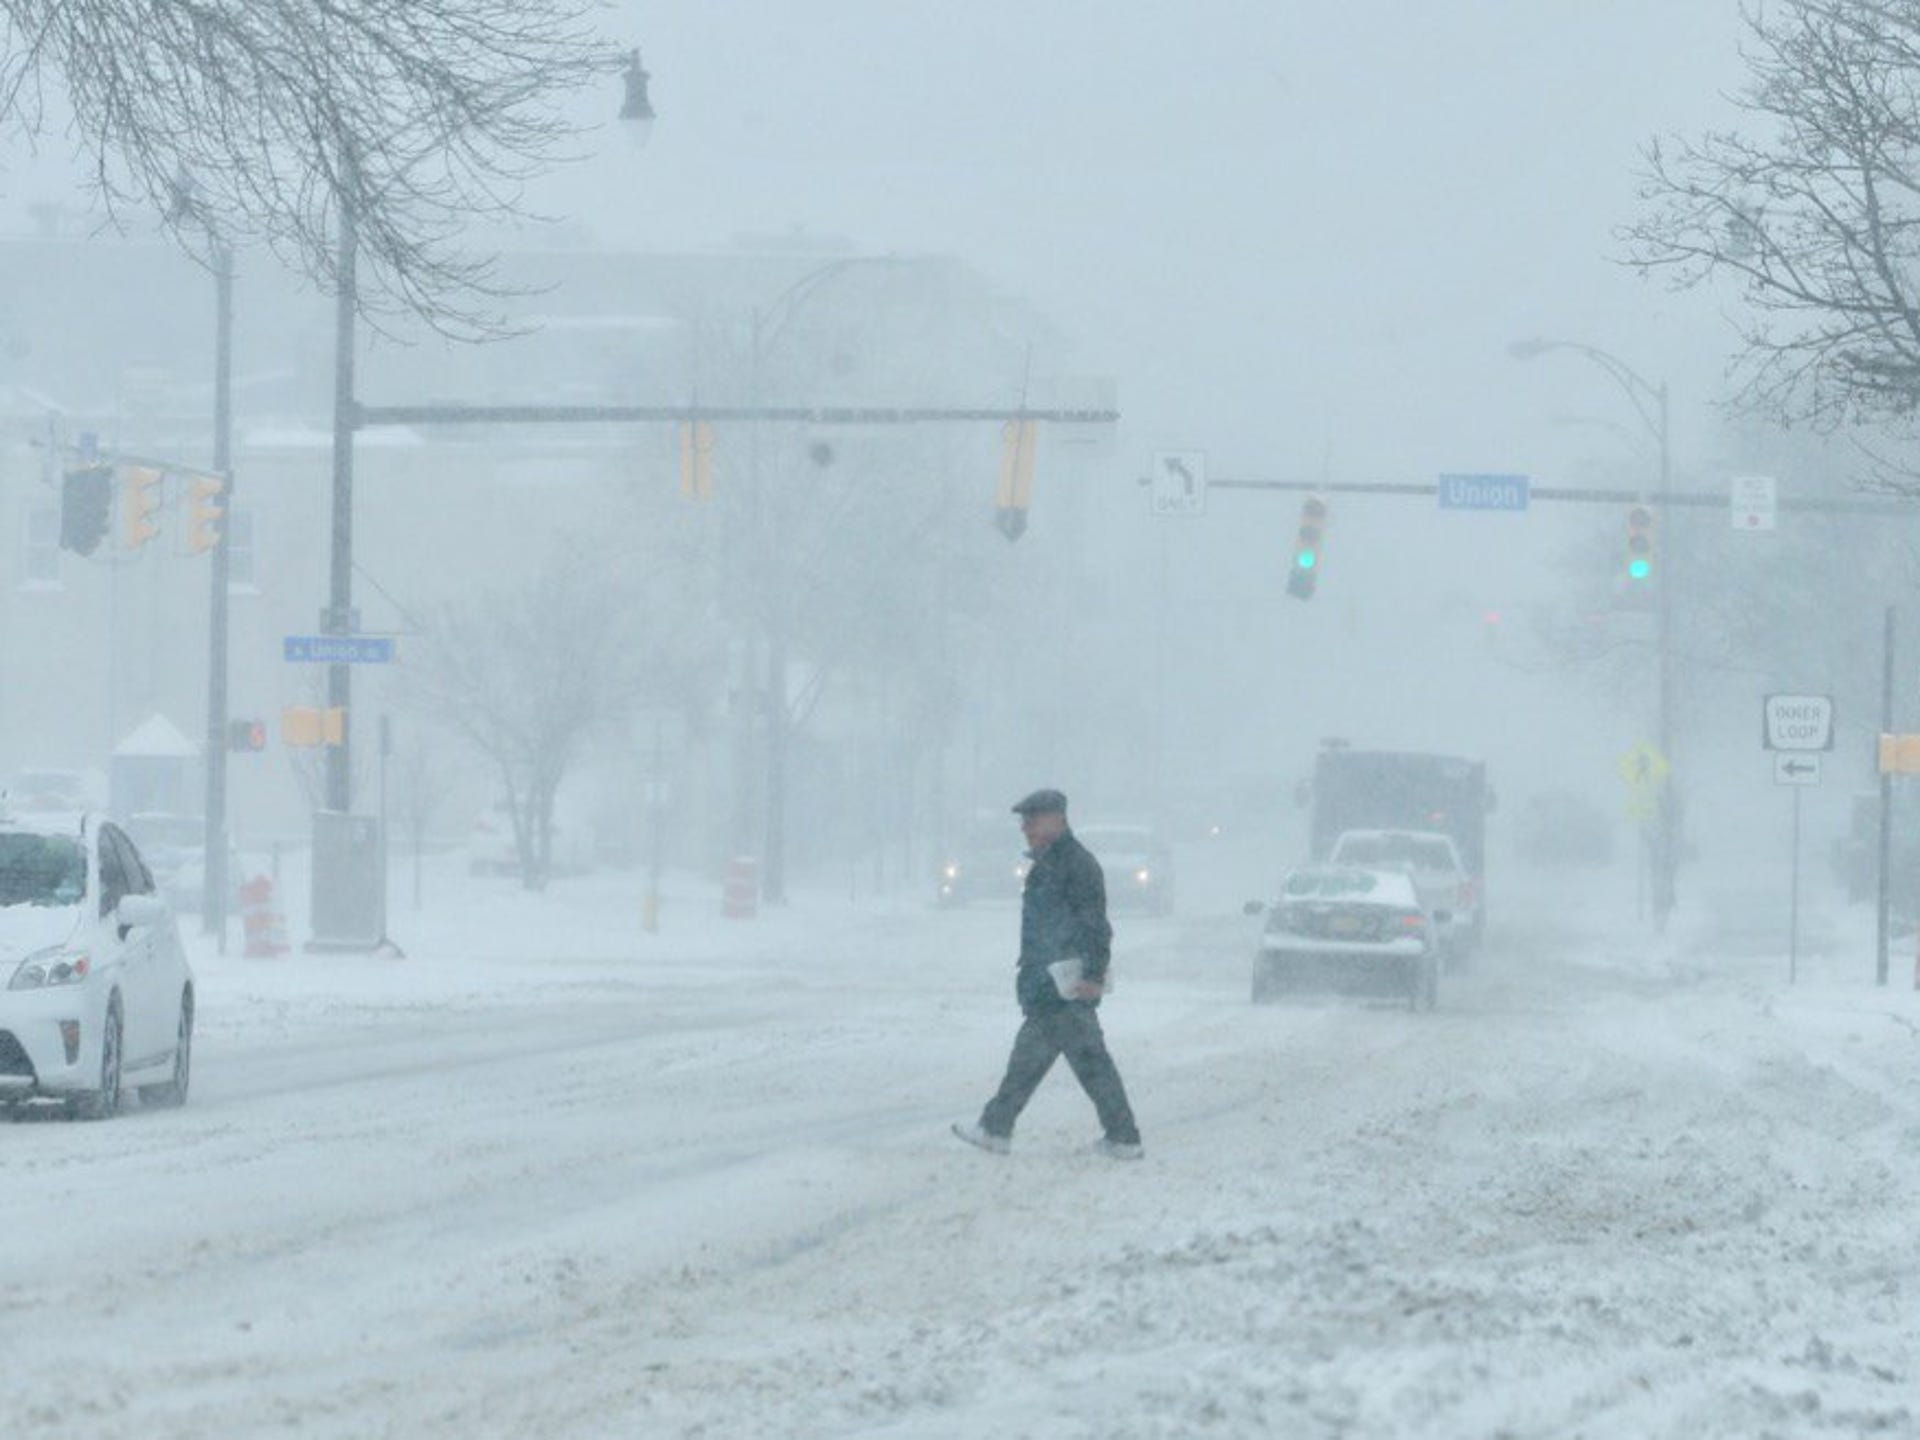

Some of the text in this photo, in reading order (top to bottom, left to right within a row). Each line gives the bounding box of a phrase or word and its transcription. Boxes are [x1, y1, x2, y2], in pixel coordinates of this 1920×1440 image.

[1448, 479, 1518, 506] Union
[1775, 705, 1820, 720] INNER
[1777, 725, 1819, 739] LOOP
